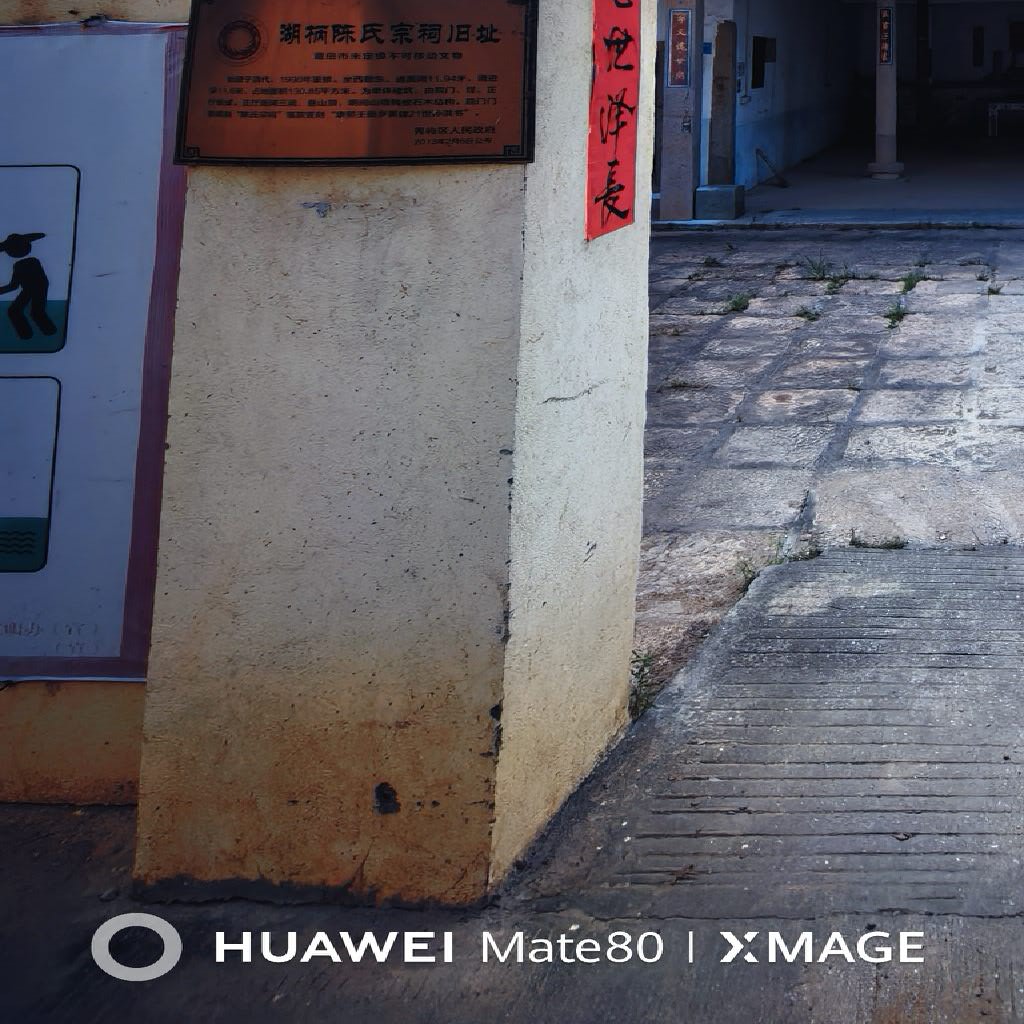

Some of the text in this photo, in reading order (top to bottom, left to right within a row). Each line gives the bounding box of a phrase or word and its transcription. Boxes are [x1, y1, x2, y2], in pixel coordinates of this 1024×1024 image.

[279, 23, 500, 44] 湖柄陈氏宗祠旧址
